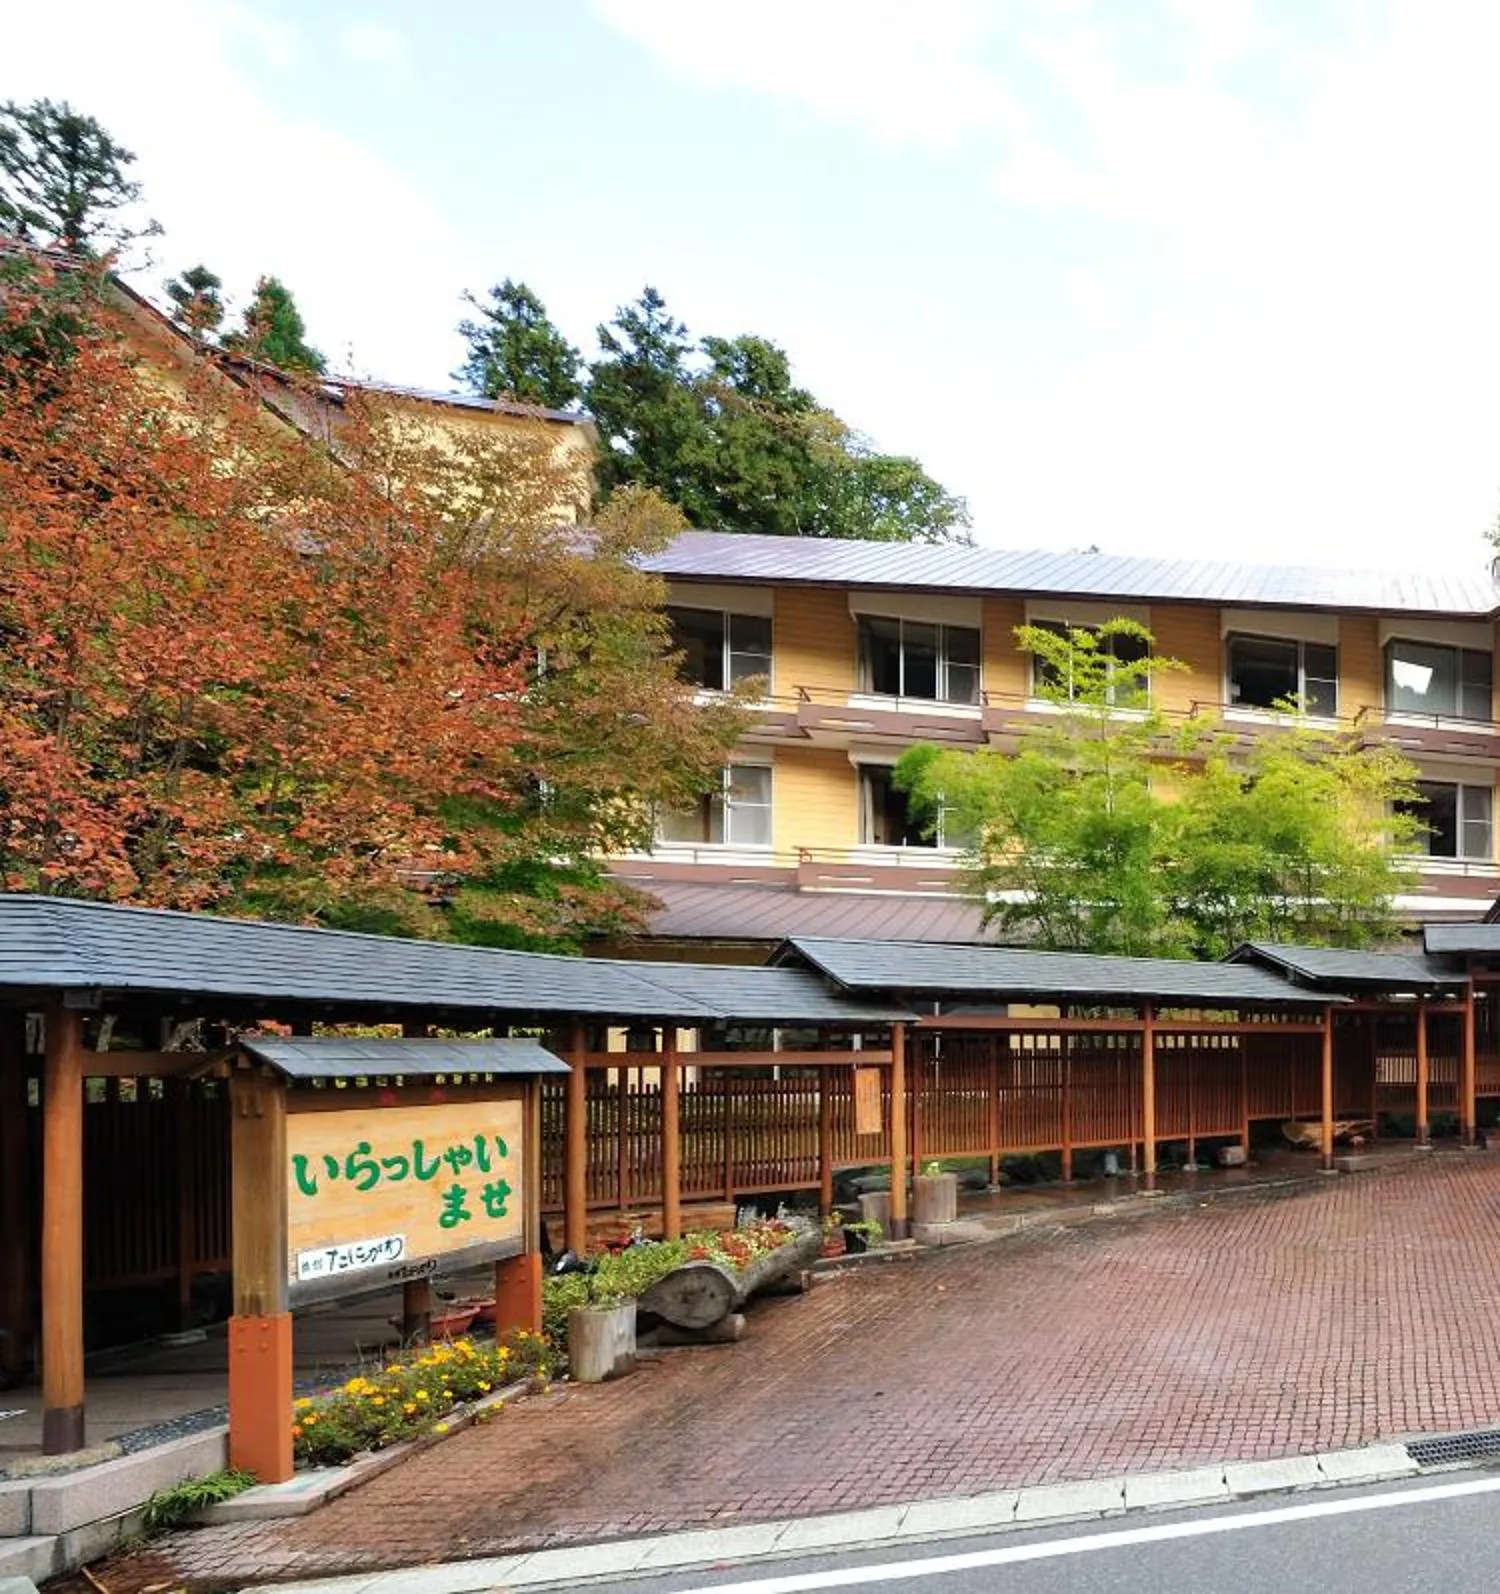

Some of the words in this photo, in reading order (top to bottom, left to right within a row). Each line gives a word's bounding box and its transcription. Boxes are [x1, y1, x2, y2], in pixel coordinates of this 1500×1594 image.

[291, 1134, 509, 1196] いらっしゃい
[438, 1179, 512, 1228] ませ
